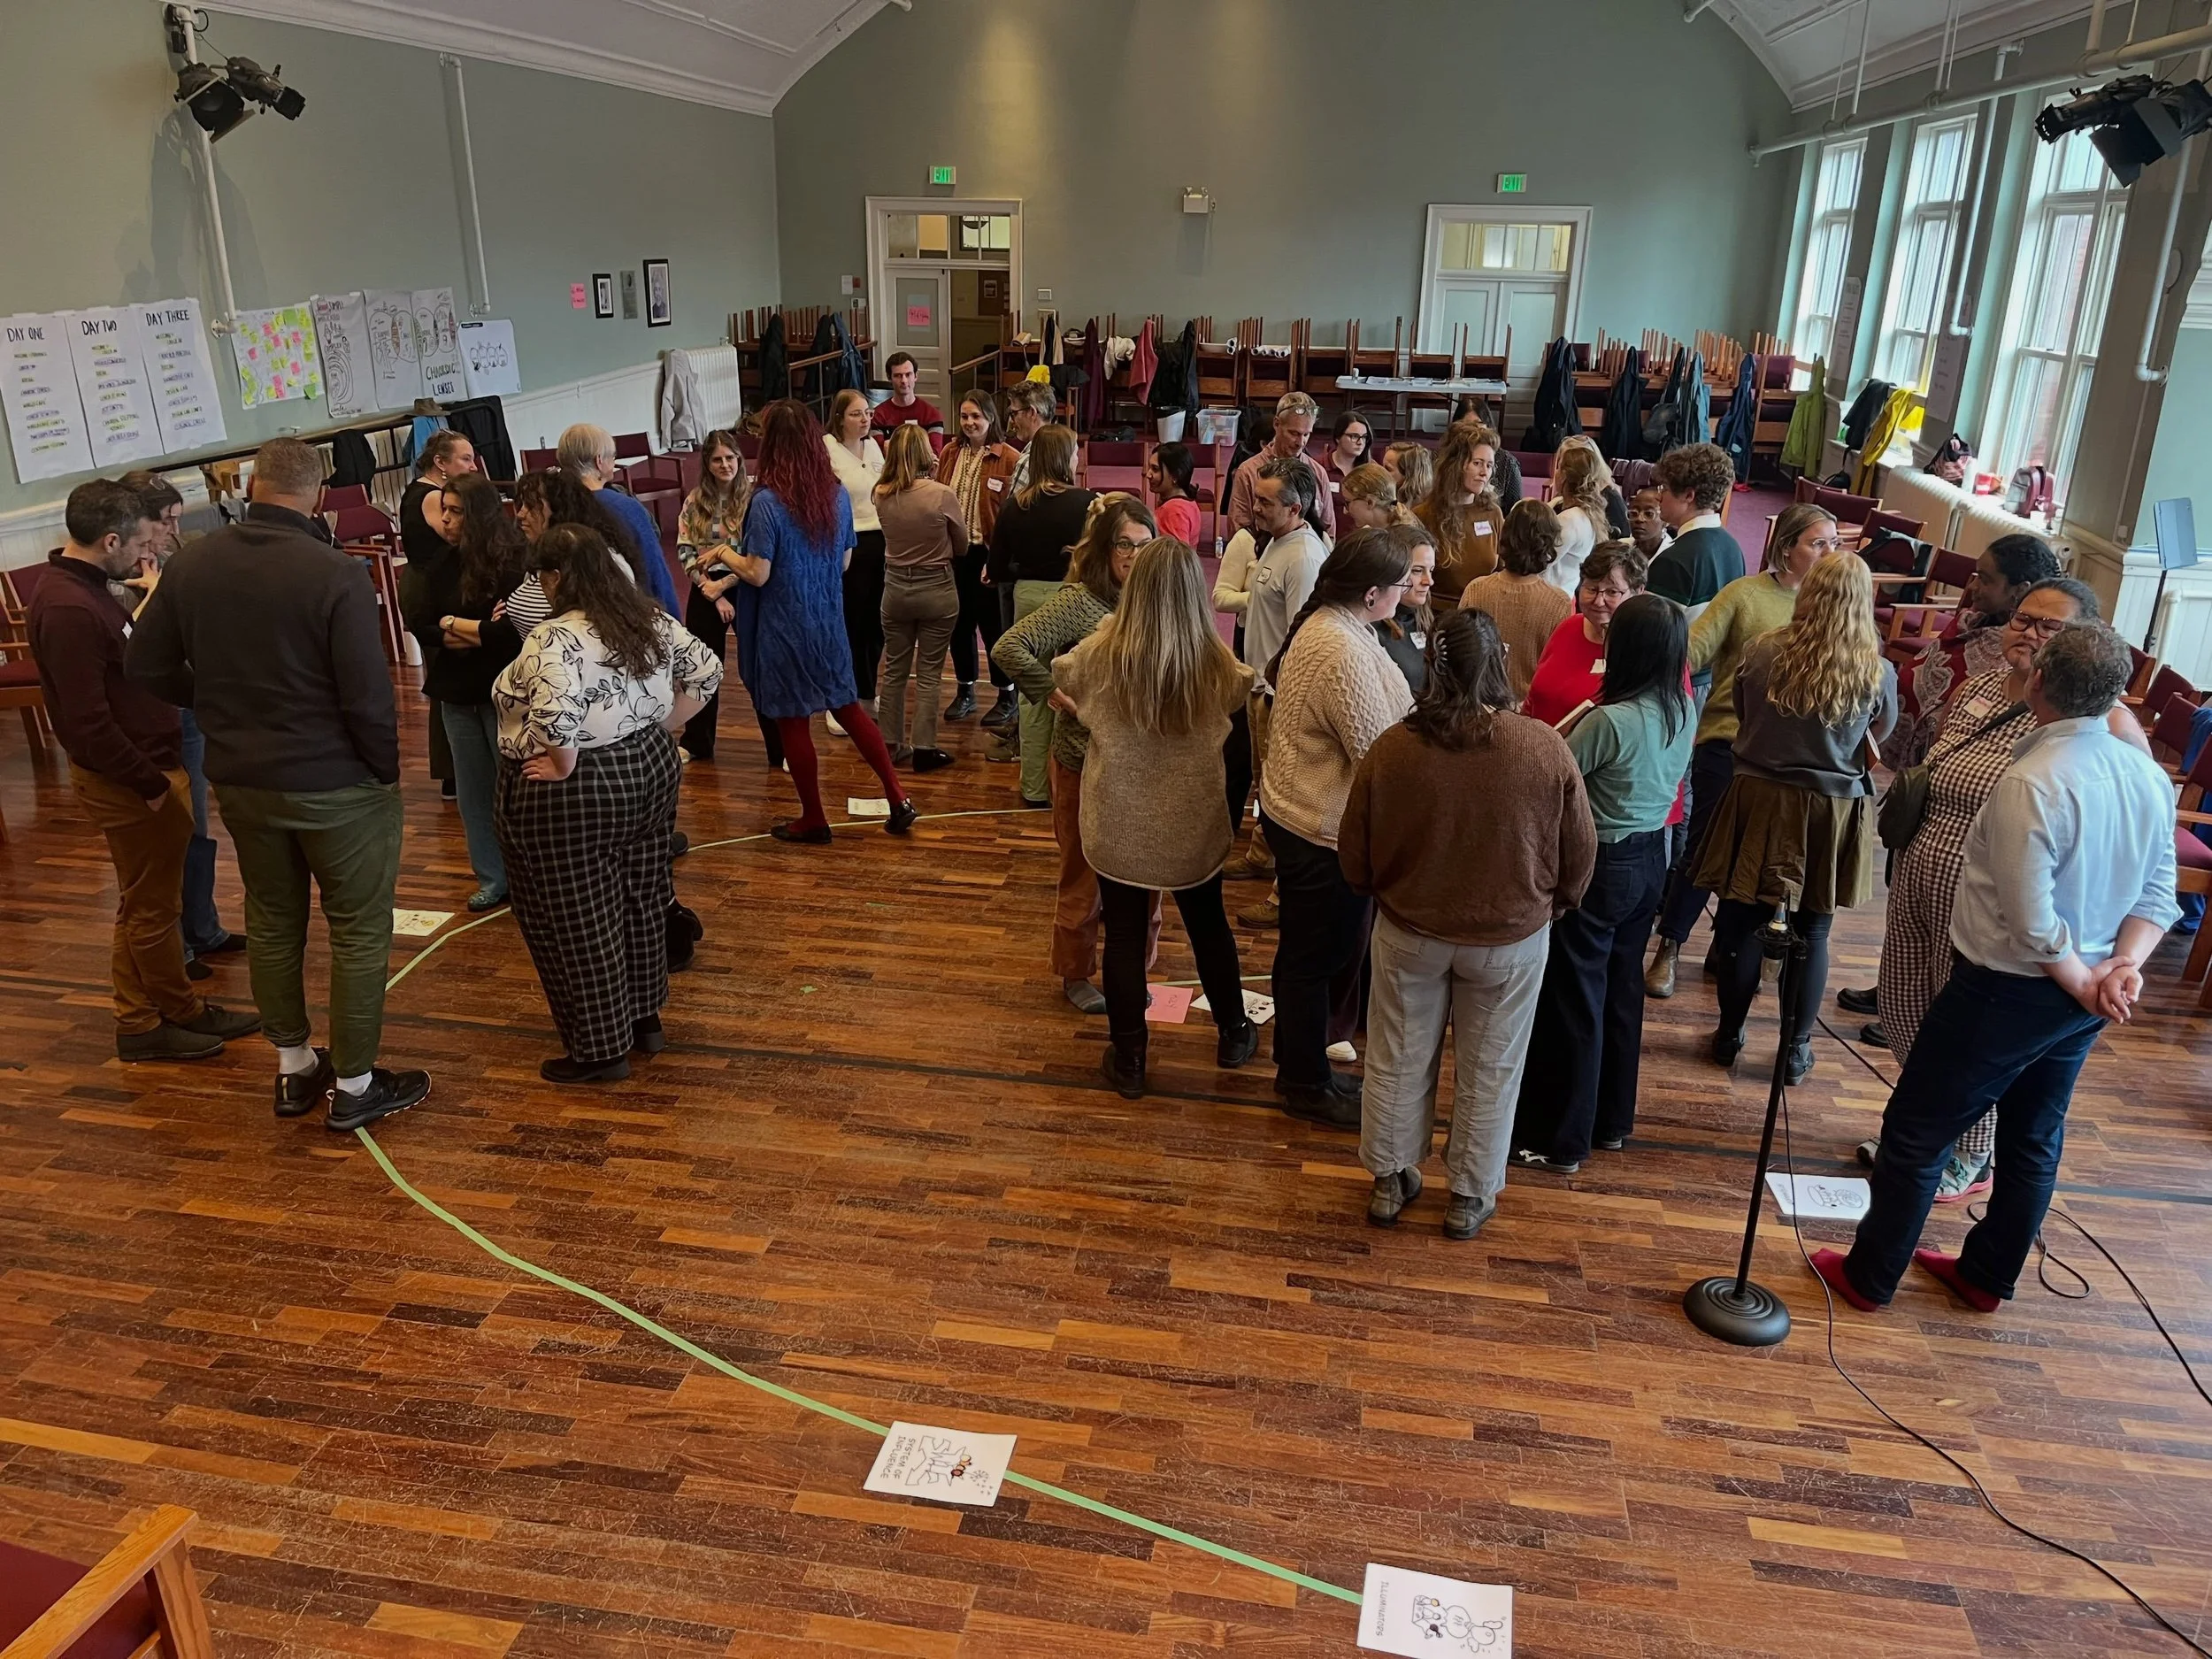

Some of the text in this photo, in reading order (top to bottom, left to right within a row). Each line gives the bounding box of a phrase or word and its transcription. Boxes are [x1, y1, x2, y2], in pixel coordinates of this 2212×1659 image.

[146, 310, 189, 326] DAY THREE
[6, 326, 45, 342] DAY ONE
[81, 319, 117, 335] DAY TWO
[432, 381, 455, 396] LENSES
[879, 1436, 906, 1479] INFLUENCE
[893, 1438, 916, 1479] SYSTEM OF
[1376, 1581, 1389, 1636] ILLUMINATORS
